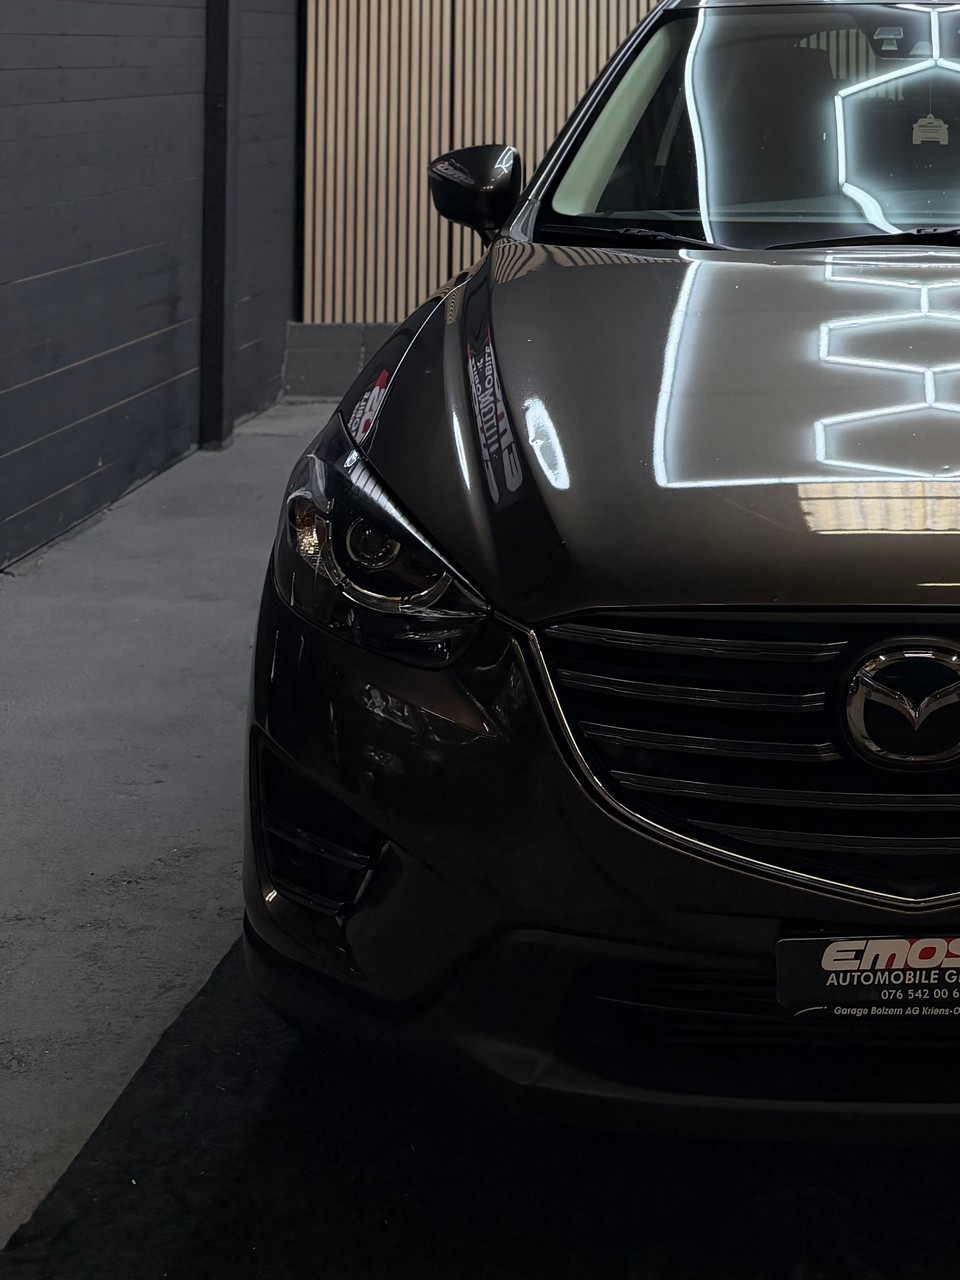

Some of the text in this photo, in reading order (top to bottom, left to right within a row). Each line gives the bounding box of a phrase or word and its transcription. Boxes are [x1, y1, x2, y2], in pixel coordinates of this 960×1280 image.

[826, 971, 939, 986] AUTOMOBILE
[881, 990, 903, 1000] 076
[908, 989, 930, 999] 542
[933, 988, 948, 999] 00
[834, 1006, 869, 1017] Garage
[870, 1006, 903, 1015] Bolzern
[905, 1006, 919, 1015] AG
